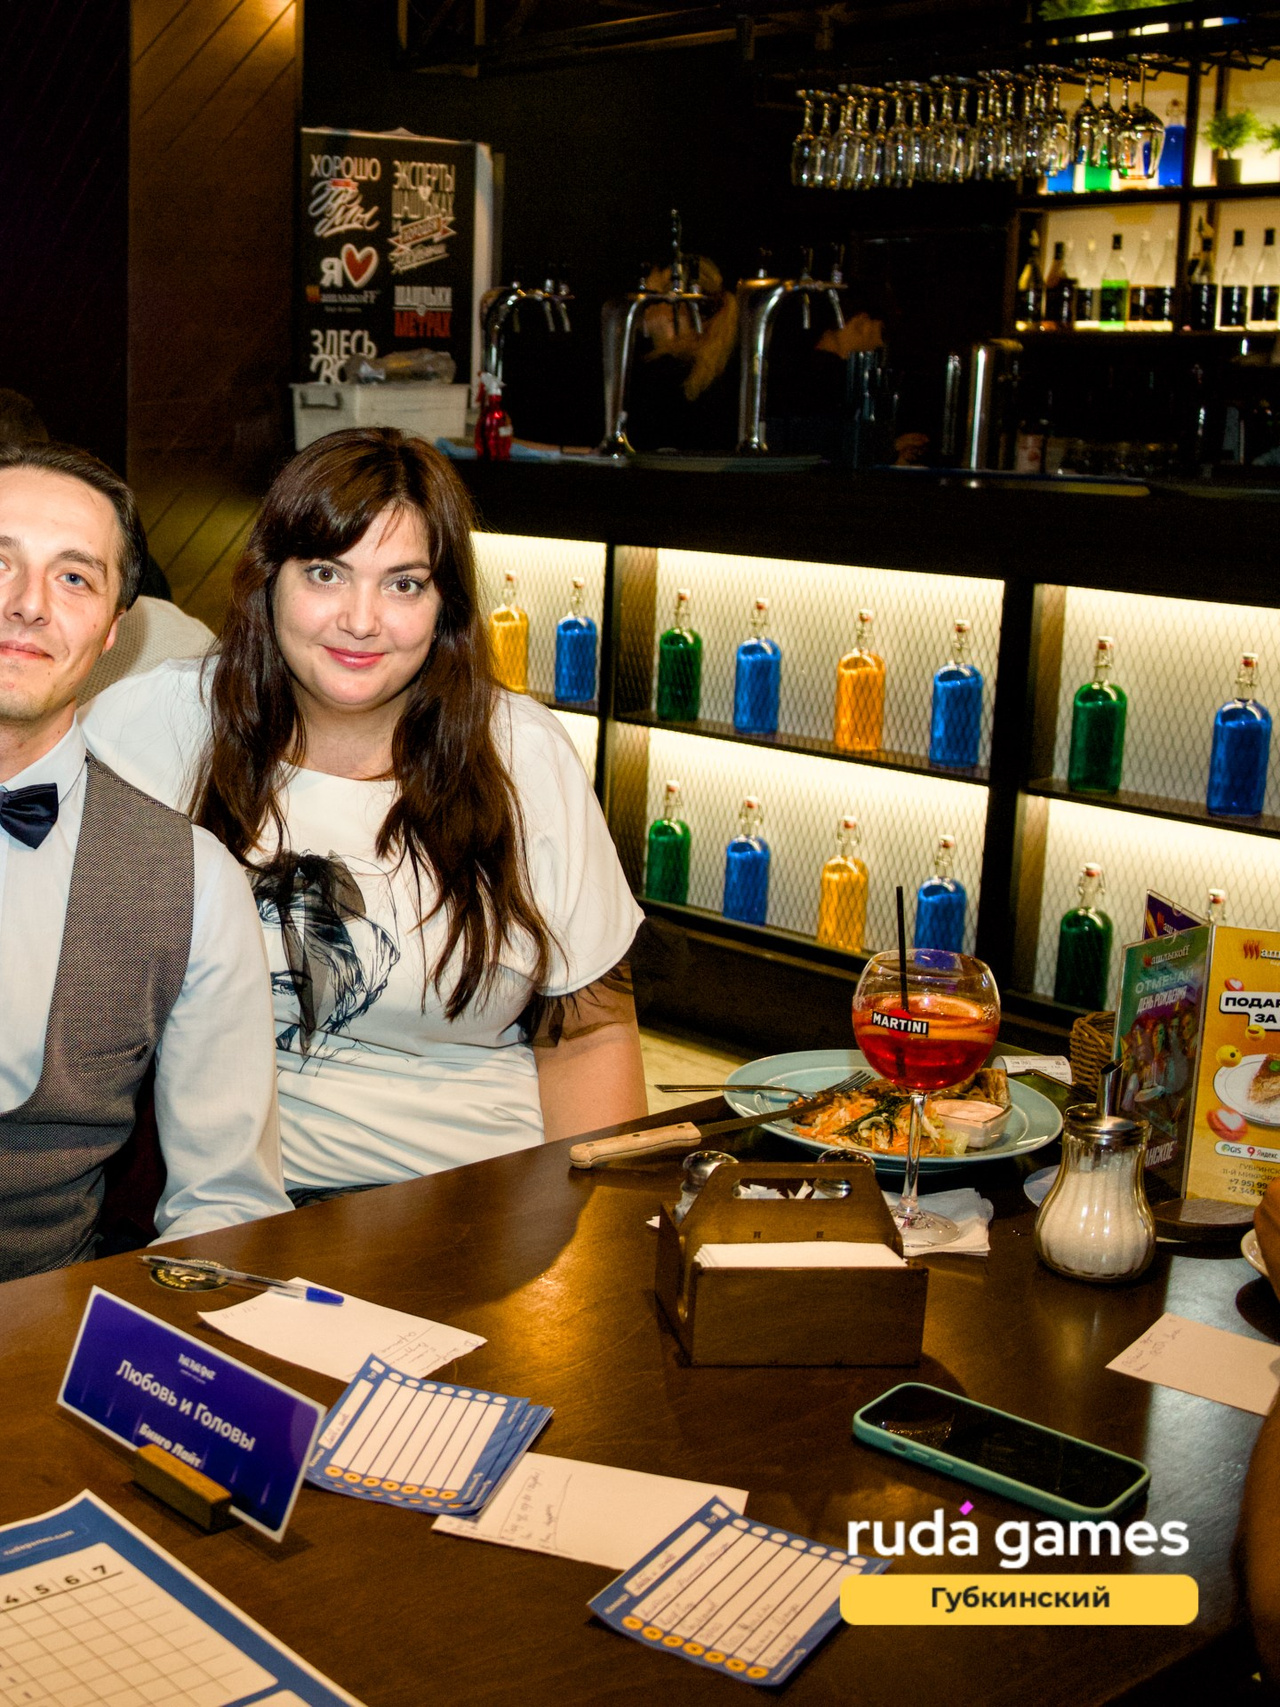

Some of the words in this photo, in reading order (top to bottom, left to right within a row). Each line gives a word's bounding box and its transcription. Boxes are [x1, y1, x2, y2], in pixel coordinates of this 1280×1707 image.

[310, 154, 381, 181] ХОРОШО
[321, 257, 343, 287] Я
[310, 329, 377, 359] ЗДЕСЬ
[1135, 965, 1194, 994] ОТМЕЧАЙ
[872, 1012, 927, 1034] MARTINI
[1254, 1013, 1277, 1024] ЗА
[116, 1359, 178, 1407] Любовь
[179, 1398, 193, 1416] и
[193, 1402, 256, 1452] Головы
[138, 1422, 172, 1450] Бинго
[171, 1442, 202, 1468] Лайт
[5, 1595, 19, 1604] 4
[34, 1584, 50, 1595] 5
[64, 1575, 80, 1585] 6
[92, 1564, 107, 1575] 7
